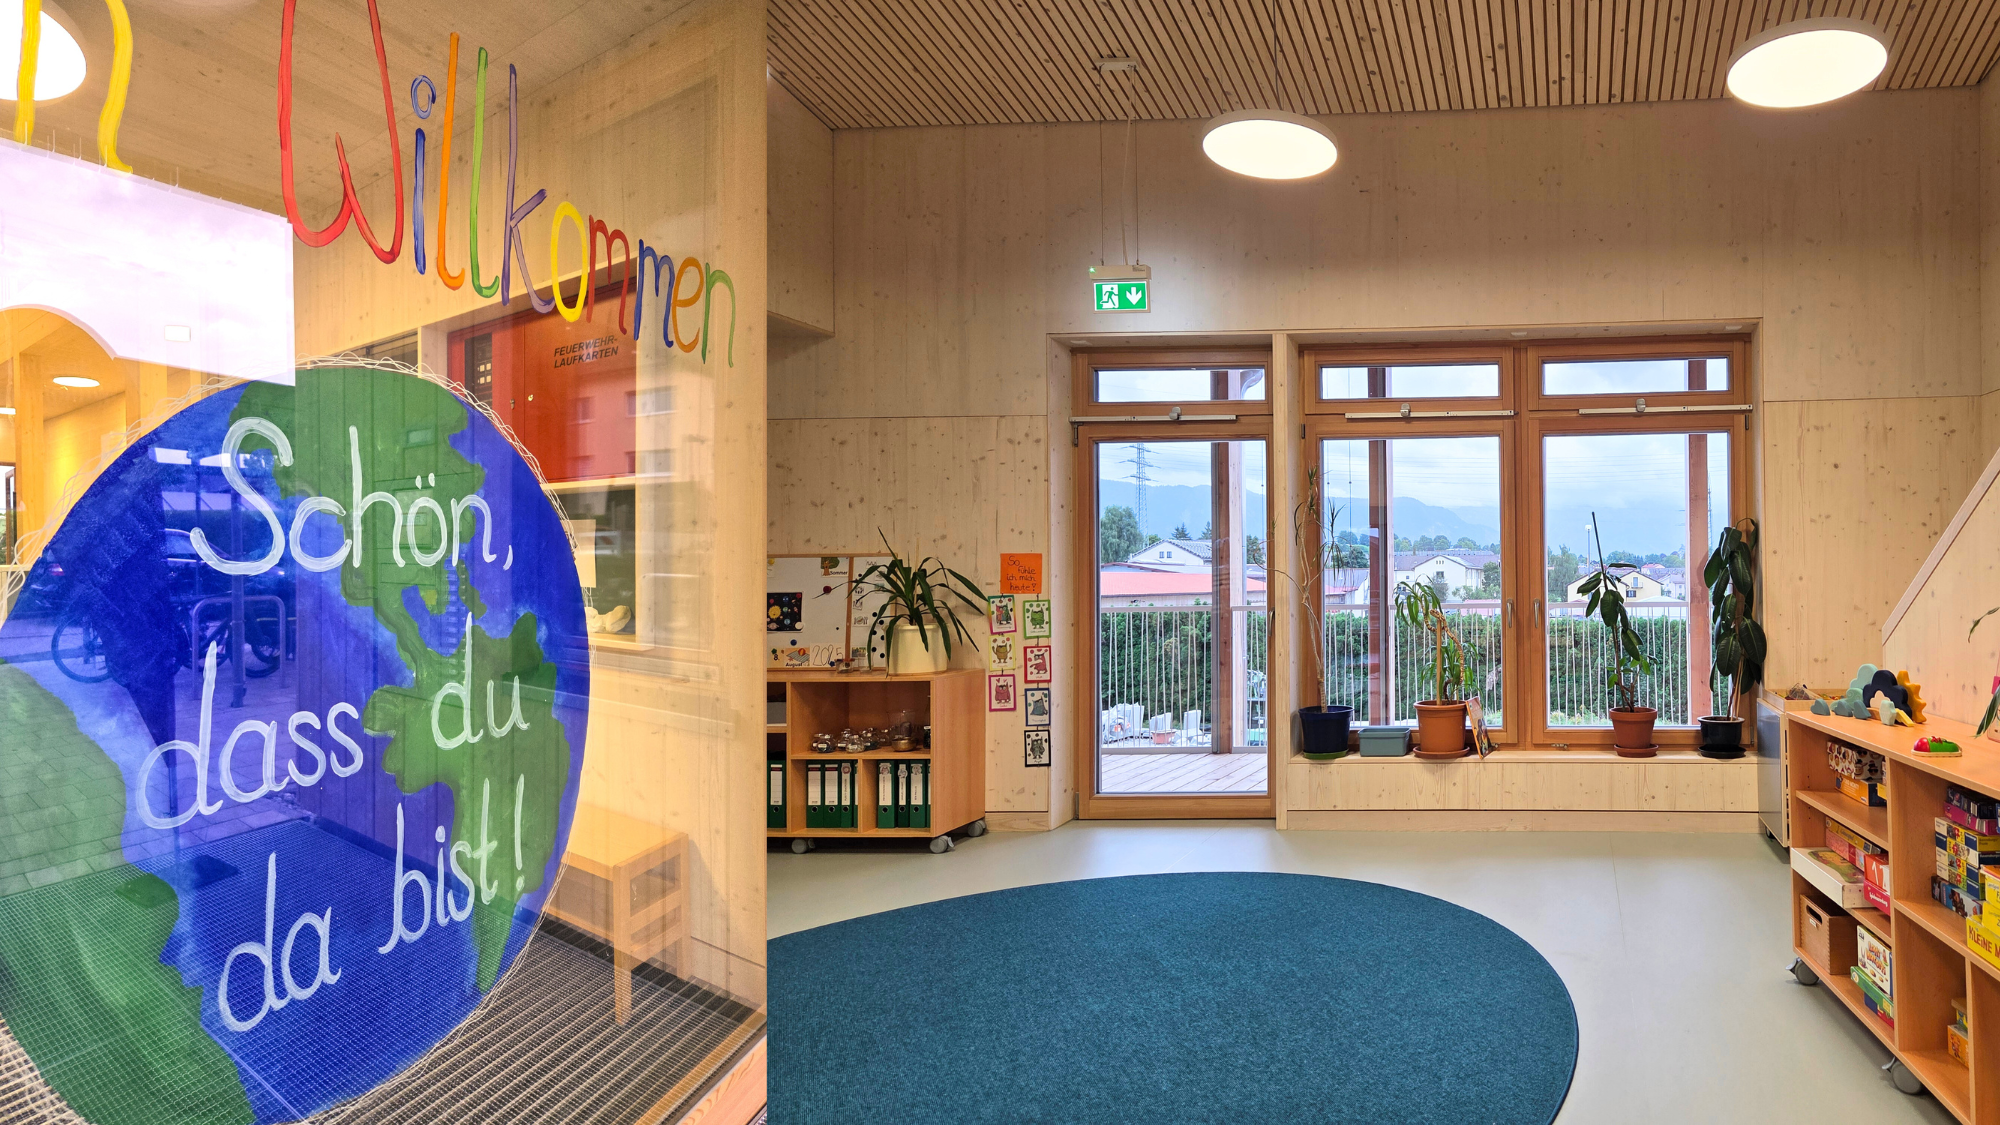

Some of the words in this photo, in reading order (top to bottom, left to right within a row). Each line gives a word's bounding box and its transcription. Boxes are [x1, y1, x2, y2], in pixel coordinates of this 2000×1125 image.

[277, 0, 736, 368] Willkommen
[554, 334, 618, 358] FEUERWEHR-
[554, 346, 619, 369] LAUFKARTEN
[190, 416, 514, 576] Schön,
[1007, 555, 1020, 567] So
[136, 641, 364, 829] dass
[430, 611, 532, 750] du
[216, 851, 342, 1033] da
[378, 773, 527, 956] bist!
